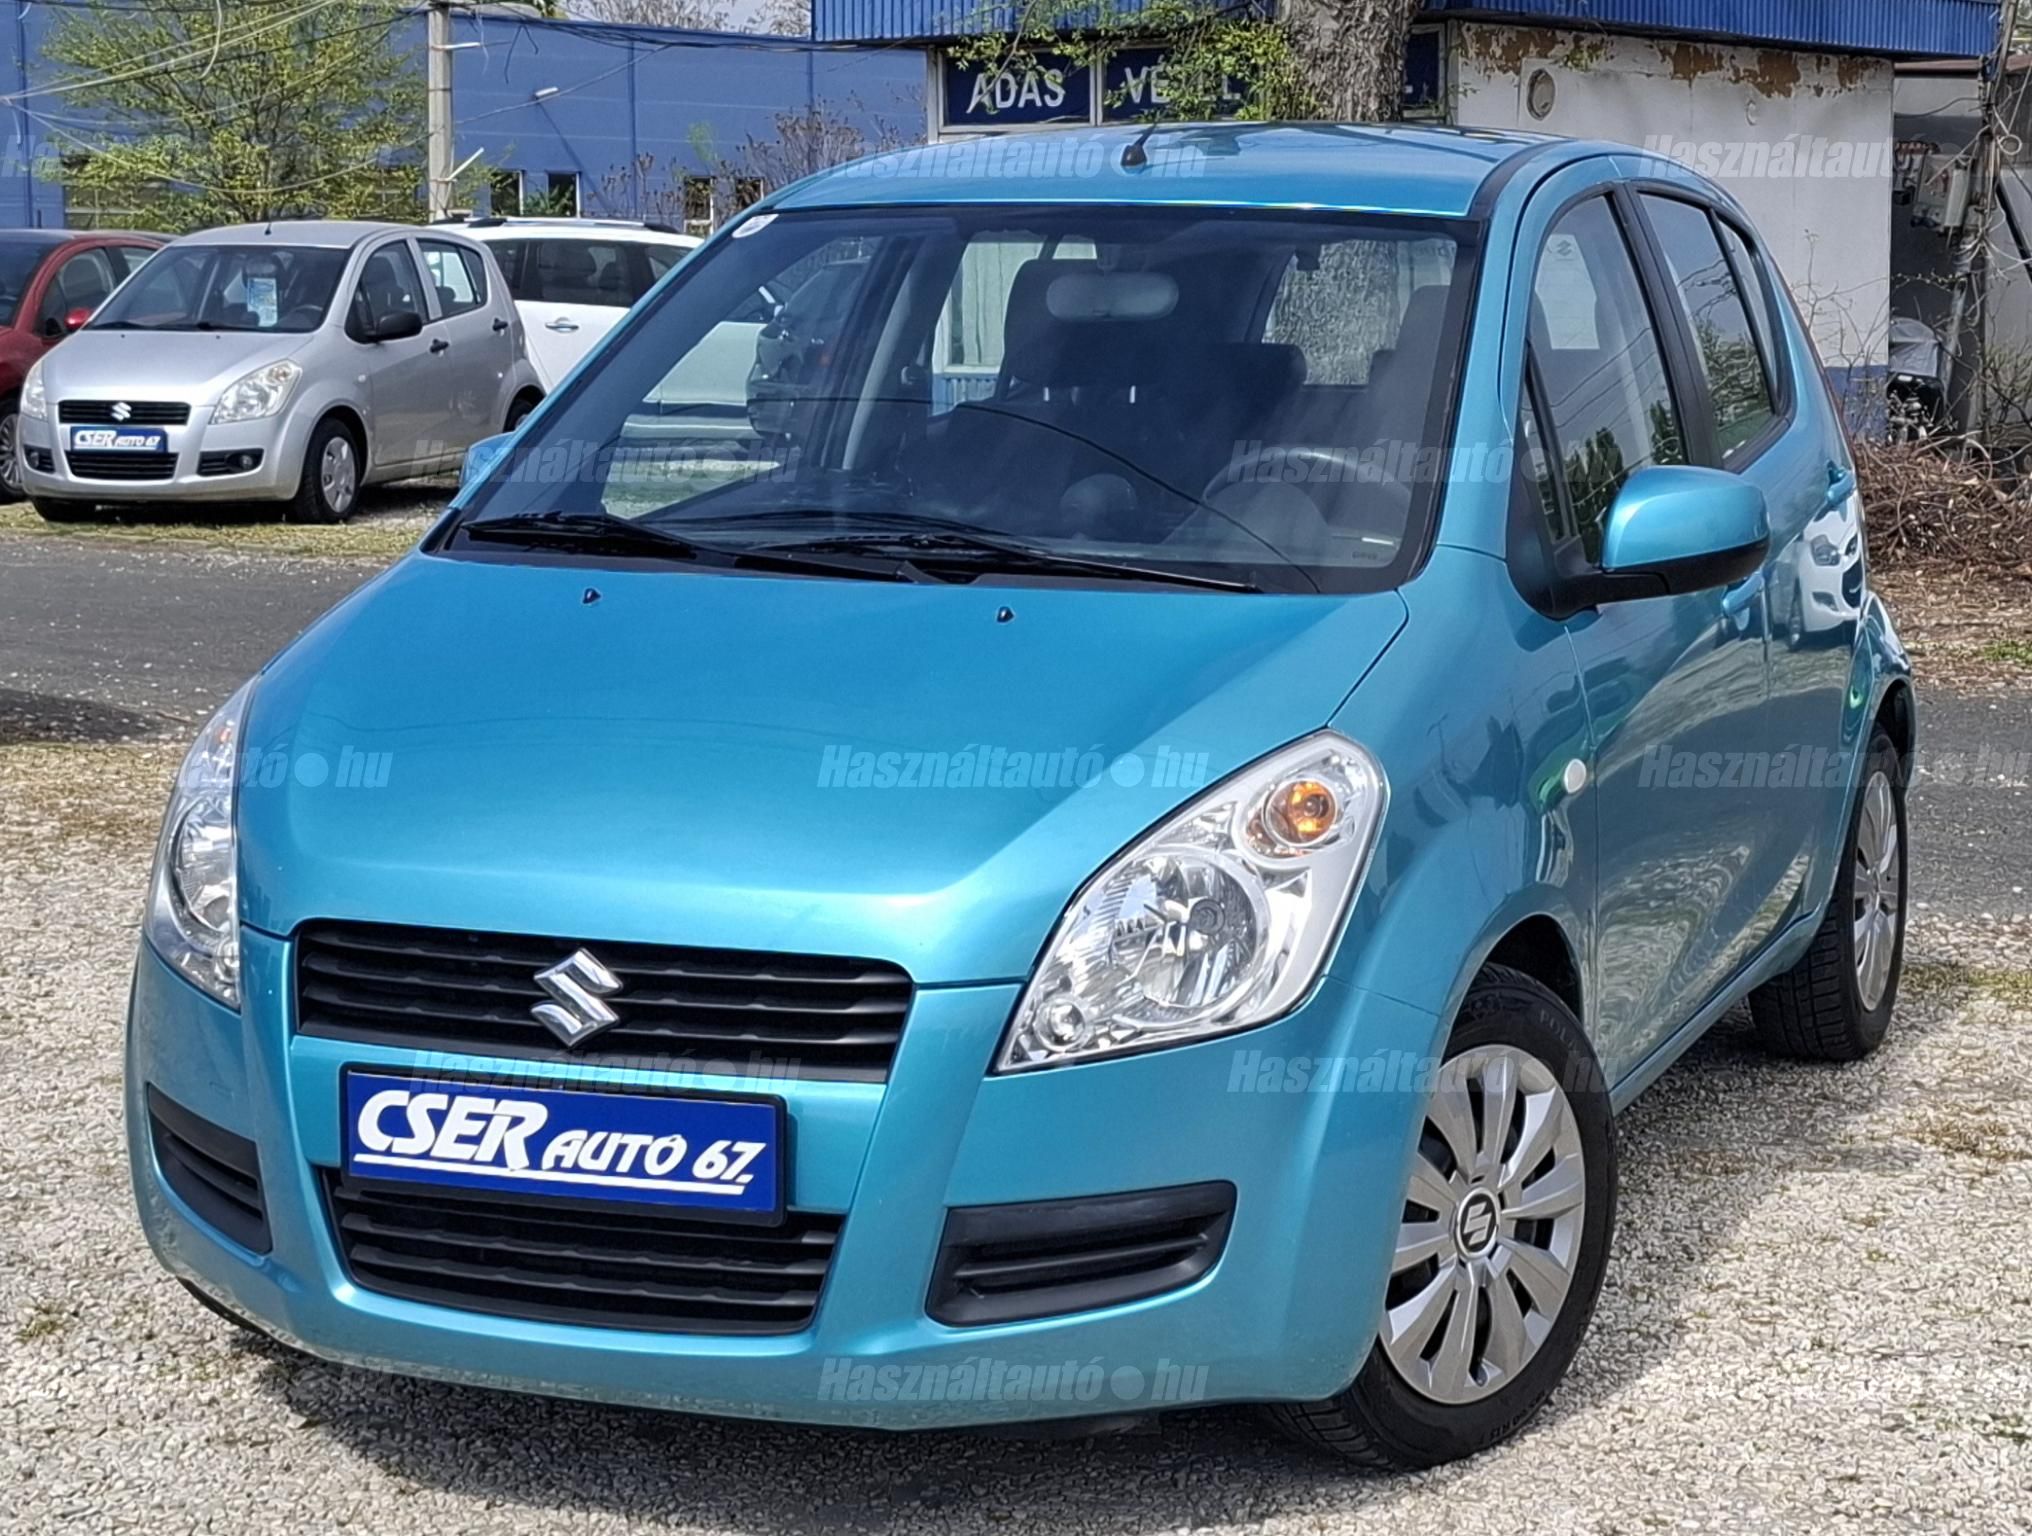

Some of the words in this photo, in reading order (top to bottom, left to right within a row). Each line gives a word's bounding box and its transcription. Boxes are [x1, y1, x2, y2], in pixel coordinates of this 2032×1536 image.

[1123, 54, 1242, 104] VÉL
[356, 1089, 549, 1172] CSER
[541, 1129, 687, 1177] AUTÓ
